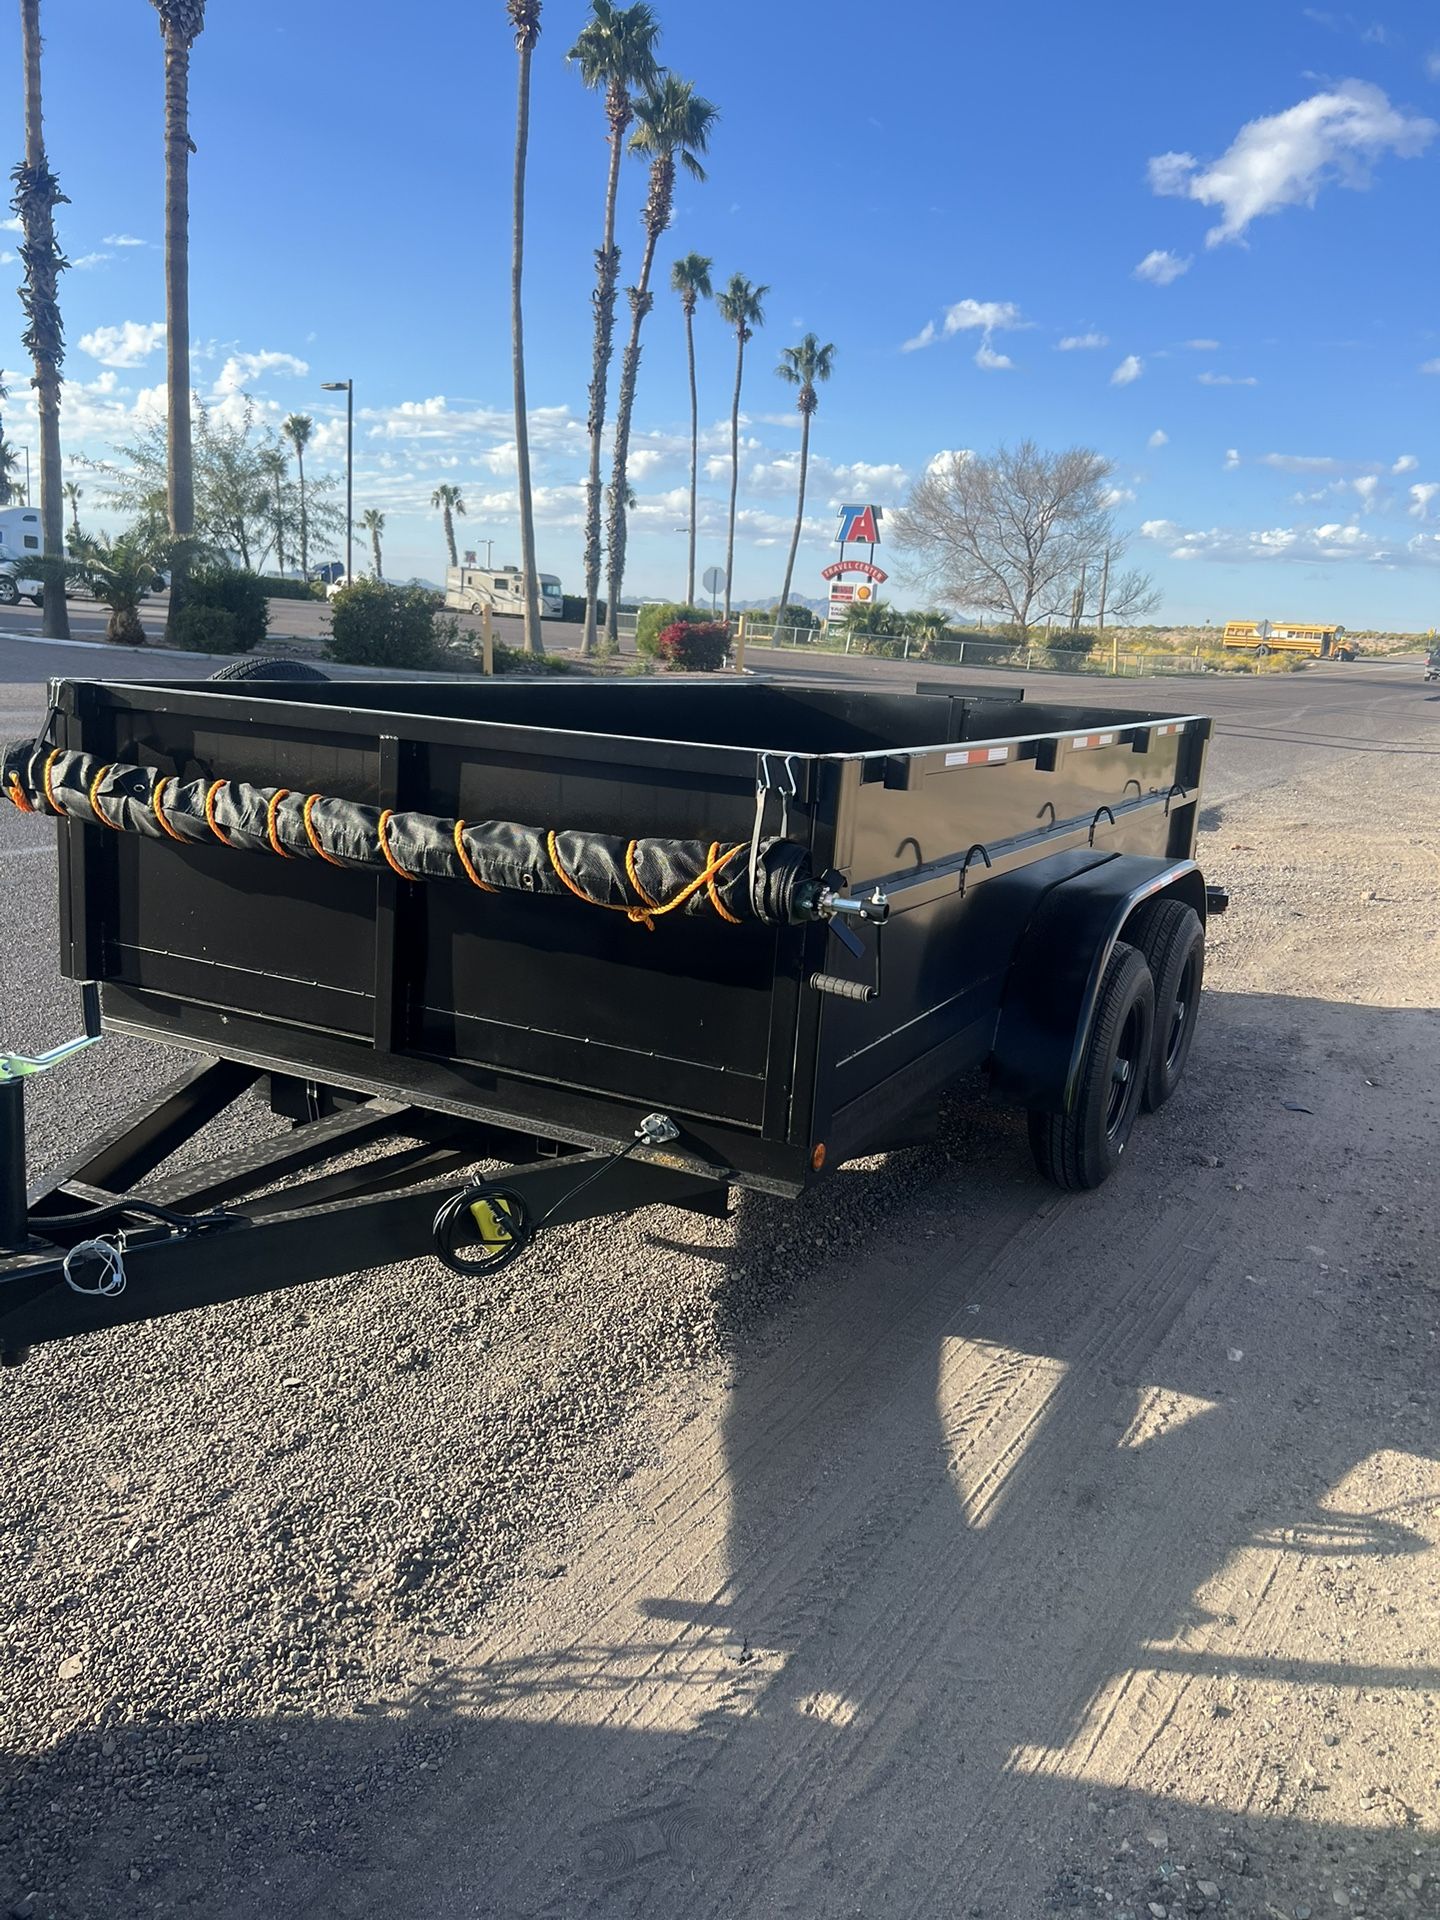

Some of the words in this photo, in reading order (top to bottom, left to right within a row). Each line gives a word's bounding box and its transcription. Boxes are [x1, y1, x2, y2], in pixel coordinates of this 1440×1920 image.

[836, 505, 879, 543] TA
[824, 562, 853, 578] TRAVEL
[854, 562, 883, 580] CENTER
